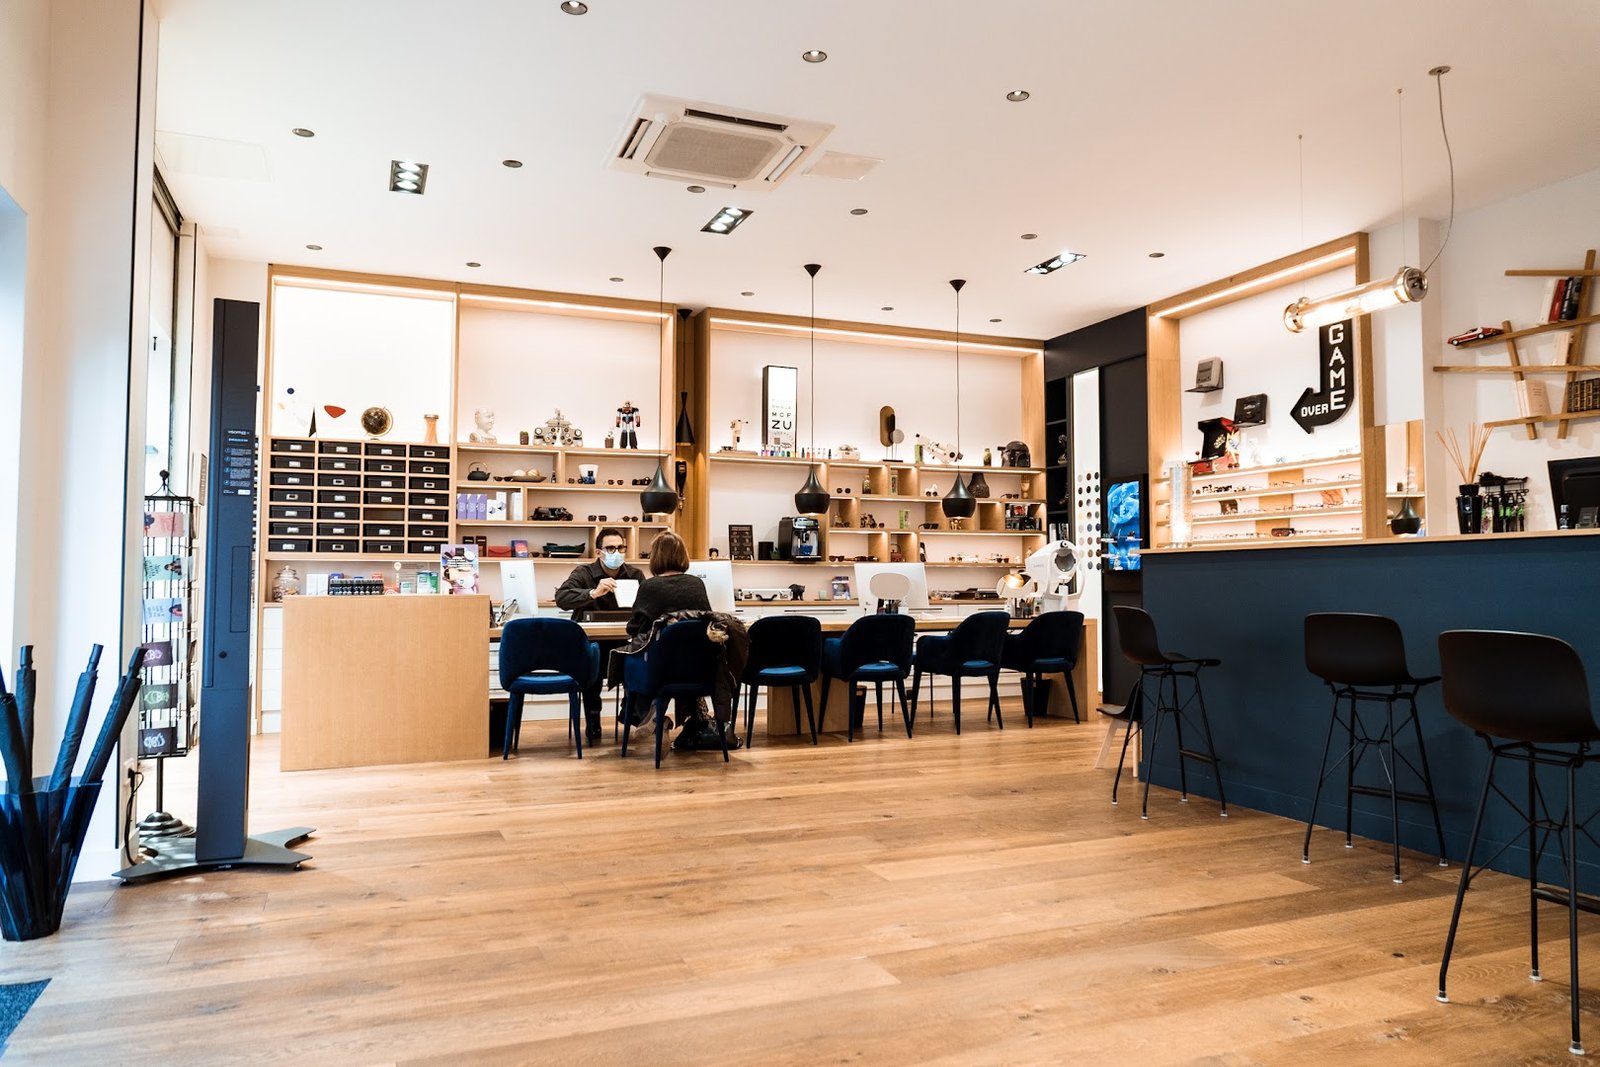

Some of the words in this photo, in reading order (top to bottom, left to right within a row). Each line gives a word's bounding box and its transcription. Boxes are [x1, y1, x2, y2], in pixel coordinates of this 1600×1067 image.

[1329, 323, 1346, 410] GAME
[1301, 403, 1329, 417] OVER
[771, 420, 792, 430] ZU
